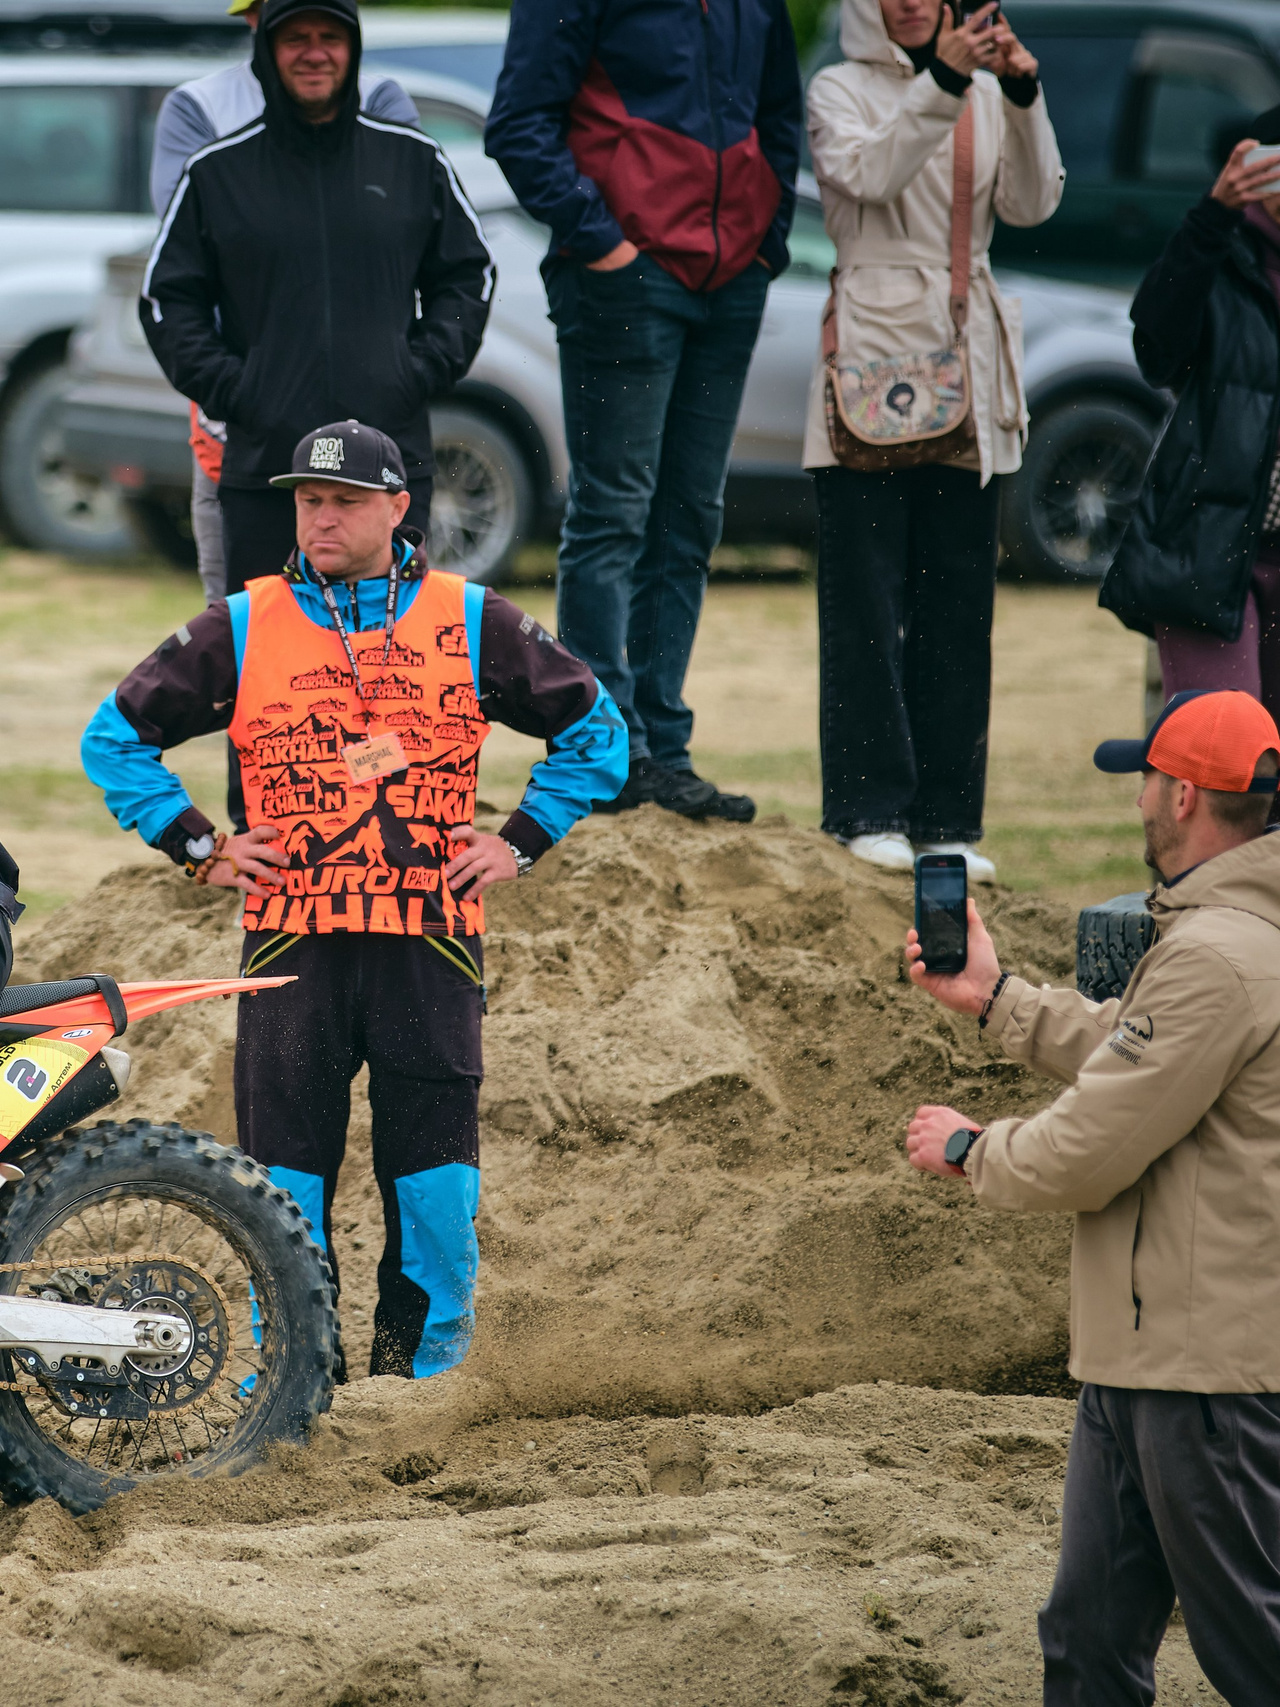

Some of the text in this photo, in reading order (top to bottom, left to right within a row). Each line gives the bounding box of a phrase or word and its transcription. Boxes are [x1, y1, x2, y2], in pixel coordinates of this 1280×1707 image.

[314, 438, 337, 454] NO
[256, 735, 319, 750] ENDURO
[408, 870, 435, 889] PARK
[1123, 1020, 1150, 1041] MAN
[6, 1058, 48, 1101] 2
